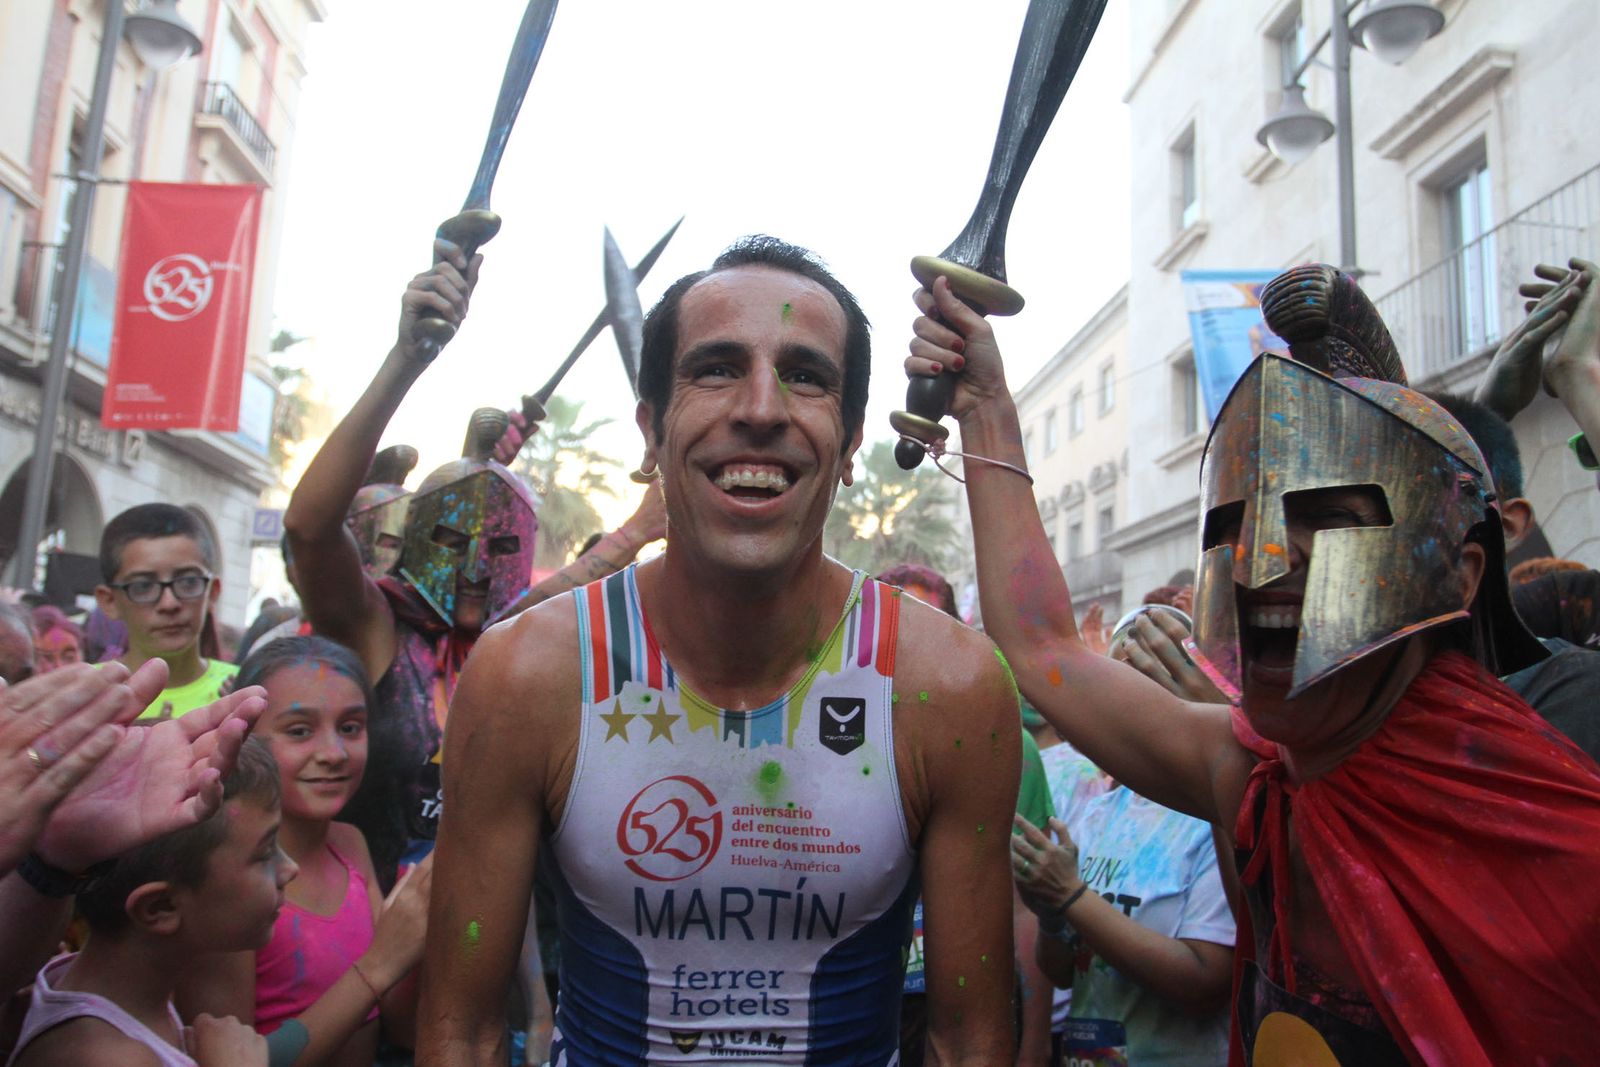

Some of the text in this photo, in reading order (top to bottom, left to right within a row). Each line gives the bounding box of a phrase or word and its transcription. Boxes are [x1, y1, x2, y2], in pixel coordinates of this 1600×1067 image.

[732, 804, 812, 820] aniversario
[617, 792, 723, 867] 525
[732, 819, 831, 838] del encuentro
[731, 837, 861, 854] entre dos mundos
[731, 855, 841, 873] Huelva-América
[634, 877, 846, 941] MARTÍN
[672, 964, 785, 990] ferrer
[669, 992, 790, 1016] hotels
[708, 1030, 787, 1050] UCAM
